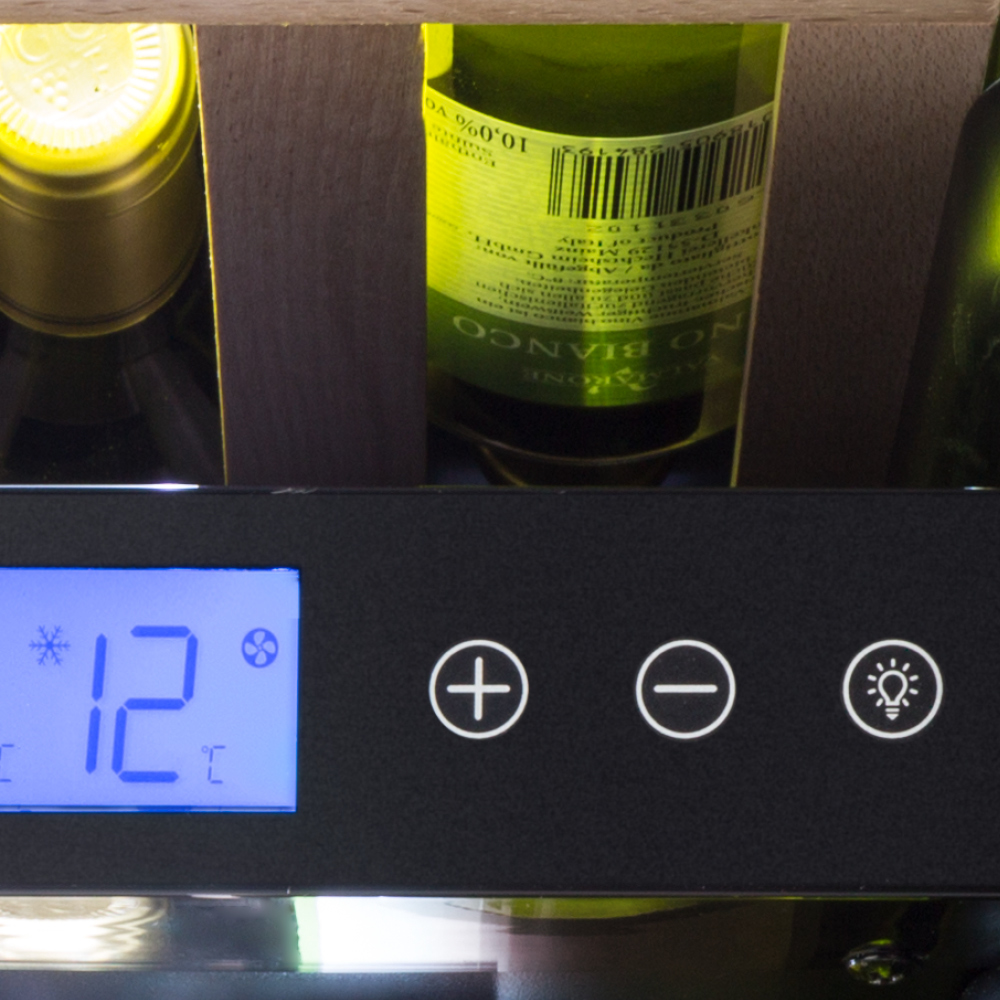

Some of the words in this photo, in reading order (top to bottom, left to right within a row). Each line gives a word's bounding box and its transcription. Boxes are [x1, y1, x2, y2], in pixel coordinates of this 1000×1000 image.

[455, 114, 527, 153] 10,0%
[453, 316, 650, 361] BIANCO
[85, 624, 199, 784] 12
